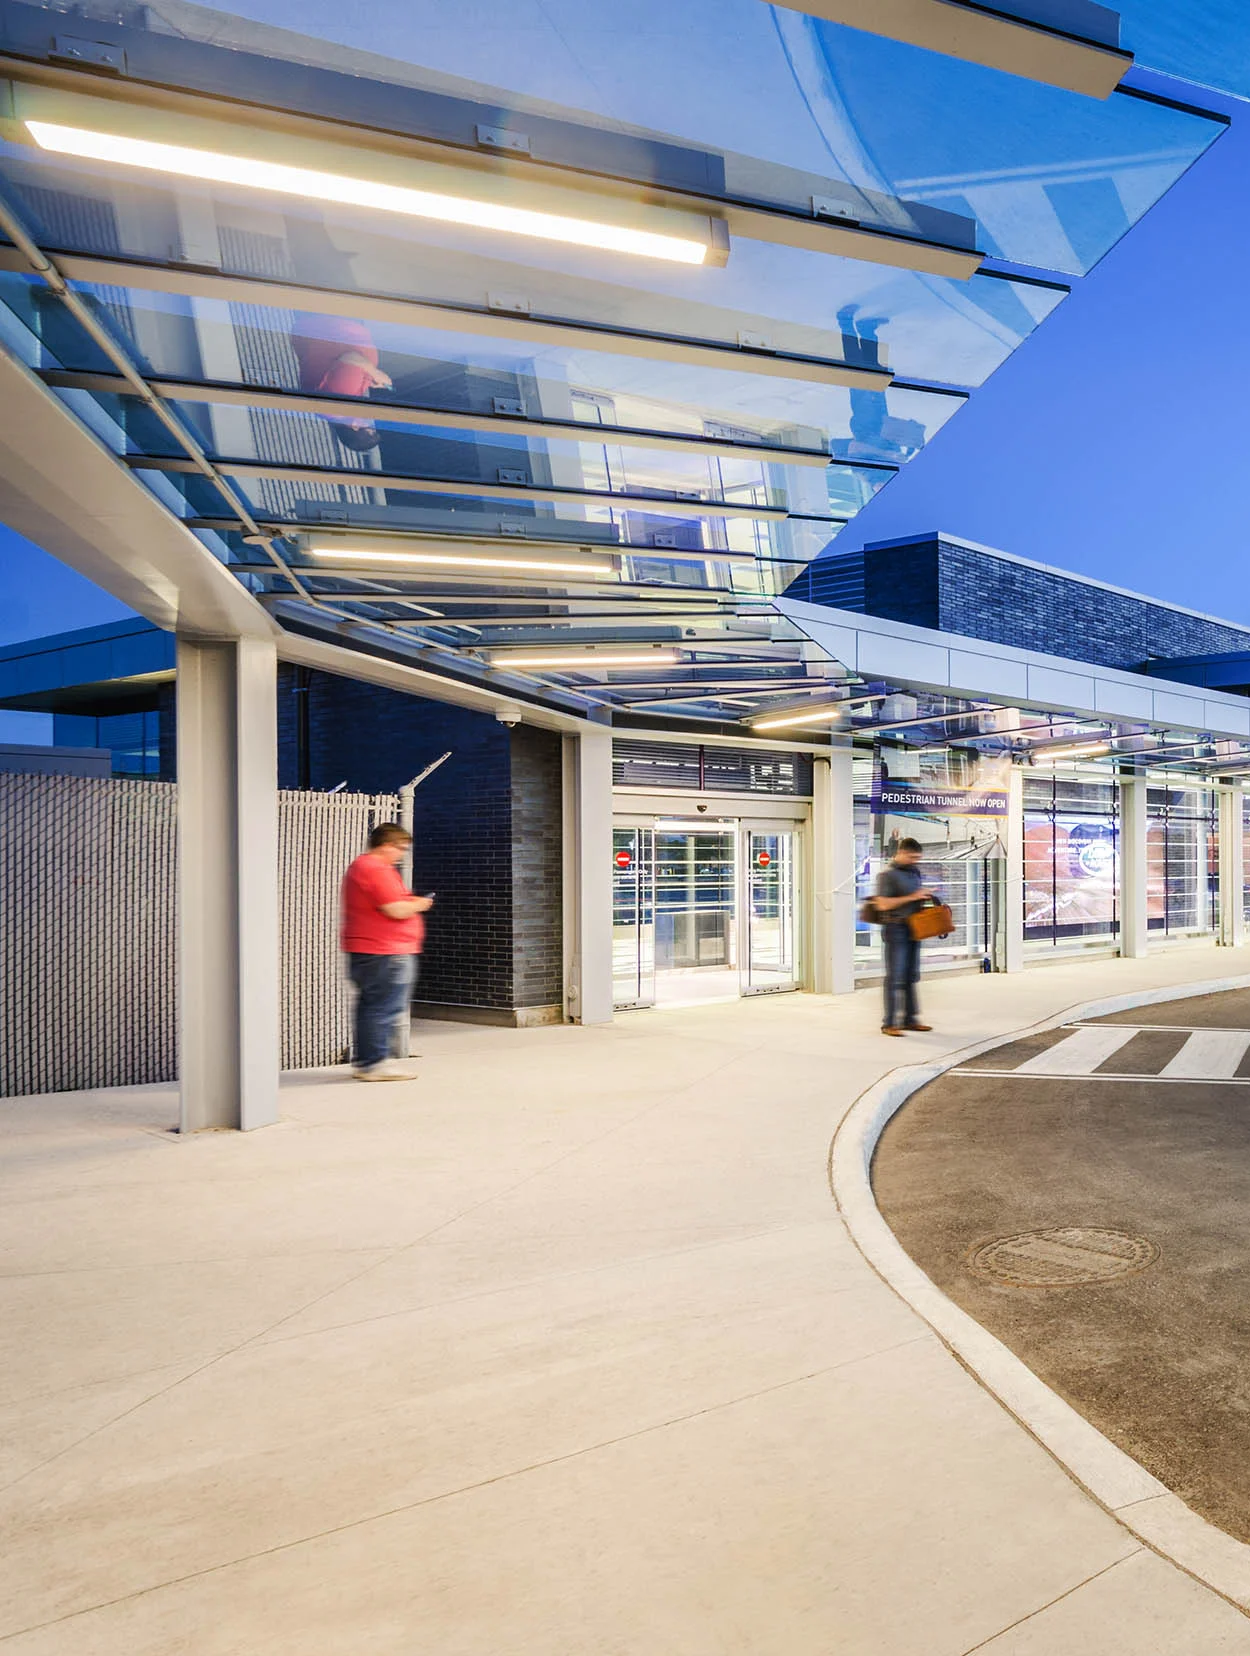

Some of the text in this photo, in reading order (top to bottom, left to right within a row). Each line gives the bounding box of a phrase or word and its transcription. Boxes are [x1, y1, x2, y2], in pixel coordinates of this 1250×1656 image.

[881, 793, 1006, 808] PEDESTRIAN TUNNEL NOW OPEN
